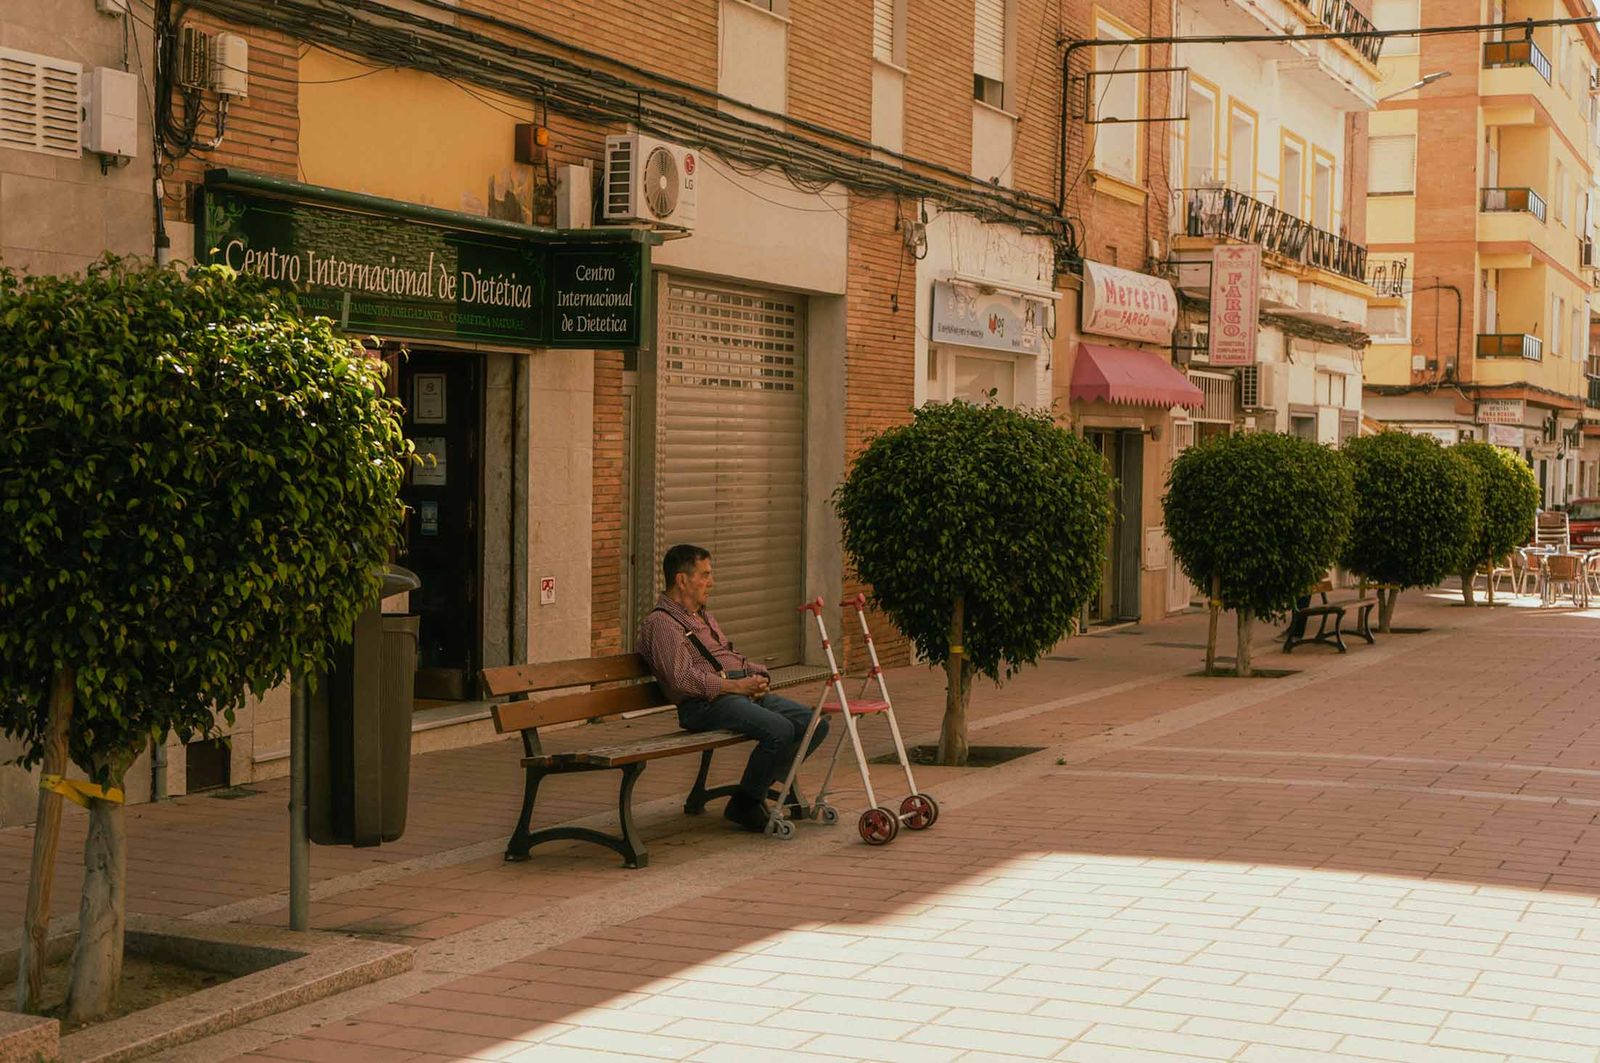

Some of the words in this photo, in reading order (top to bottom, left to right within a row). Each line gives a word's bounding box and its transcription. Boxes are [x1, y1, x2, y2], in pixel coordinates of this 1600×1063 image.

[684, 177, 694, 190] LG
[225, 240, 300, 282] Centro
[307, 251, 434, 299] Internacional
[438, 263, 457, 300] de
[460, 268, 532, 308] Dietética
[575, 265, 615, 281] Centro
[556, 282, 633, 307] Internacional
[1223, 272, 1242, 337] FARGO
[561, 313, 574, 332] de
[1120, 311, 1149, 326] FARGO
